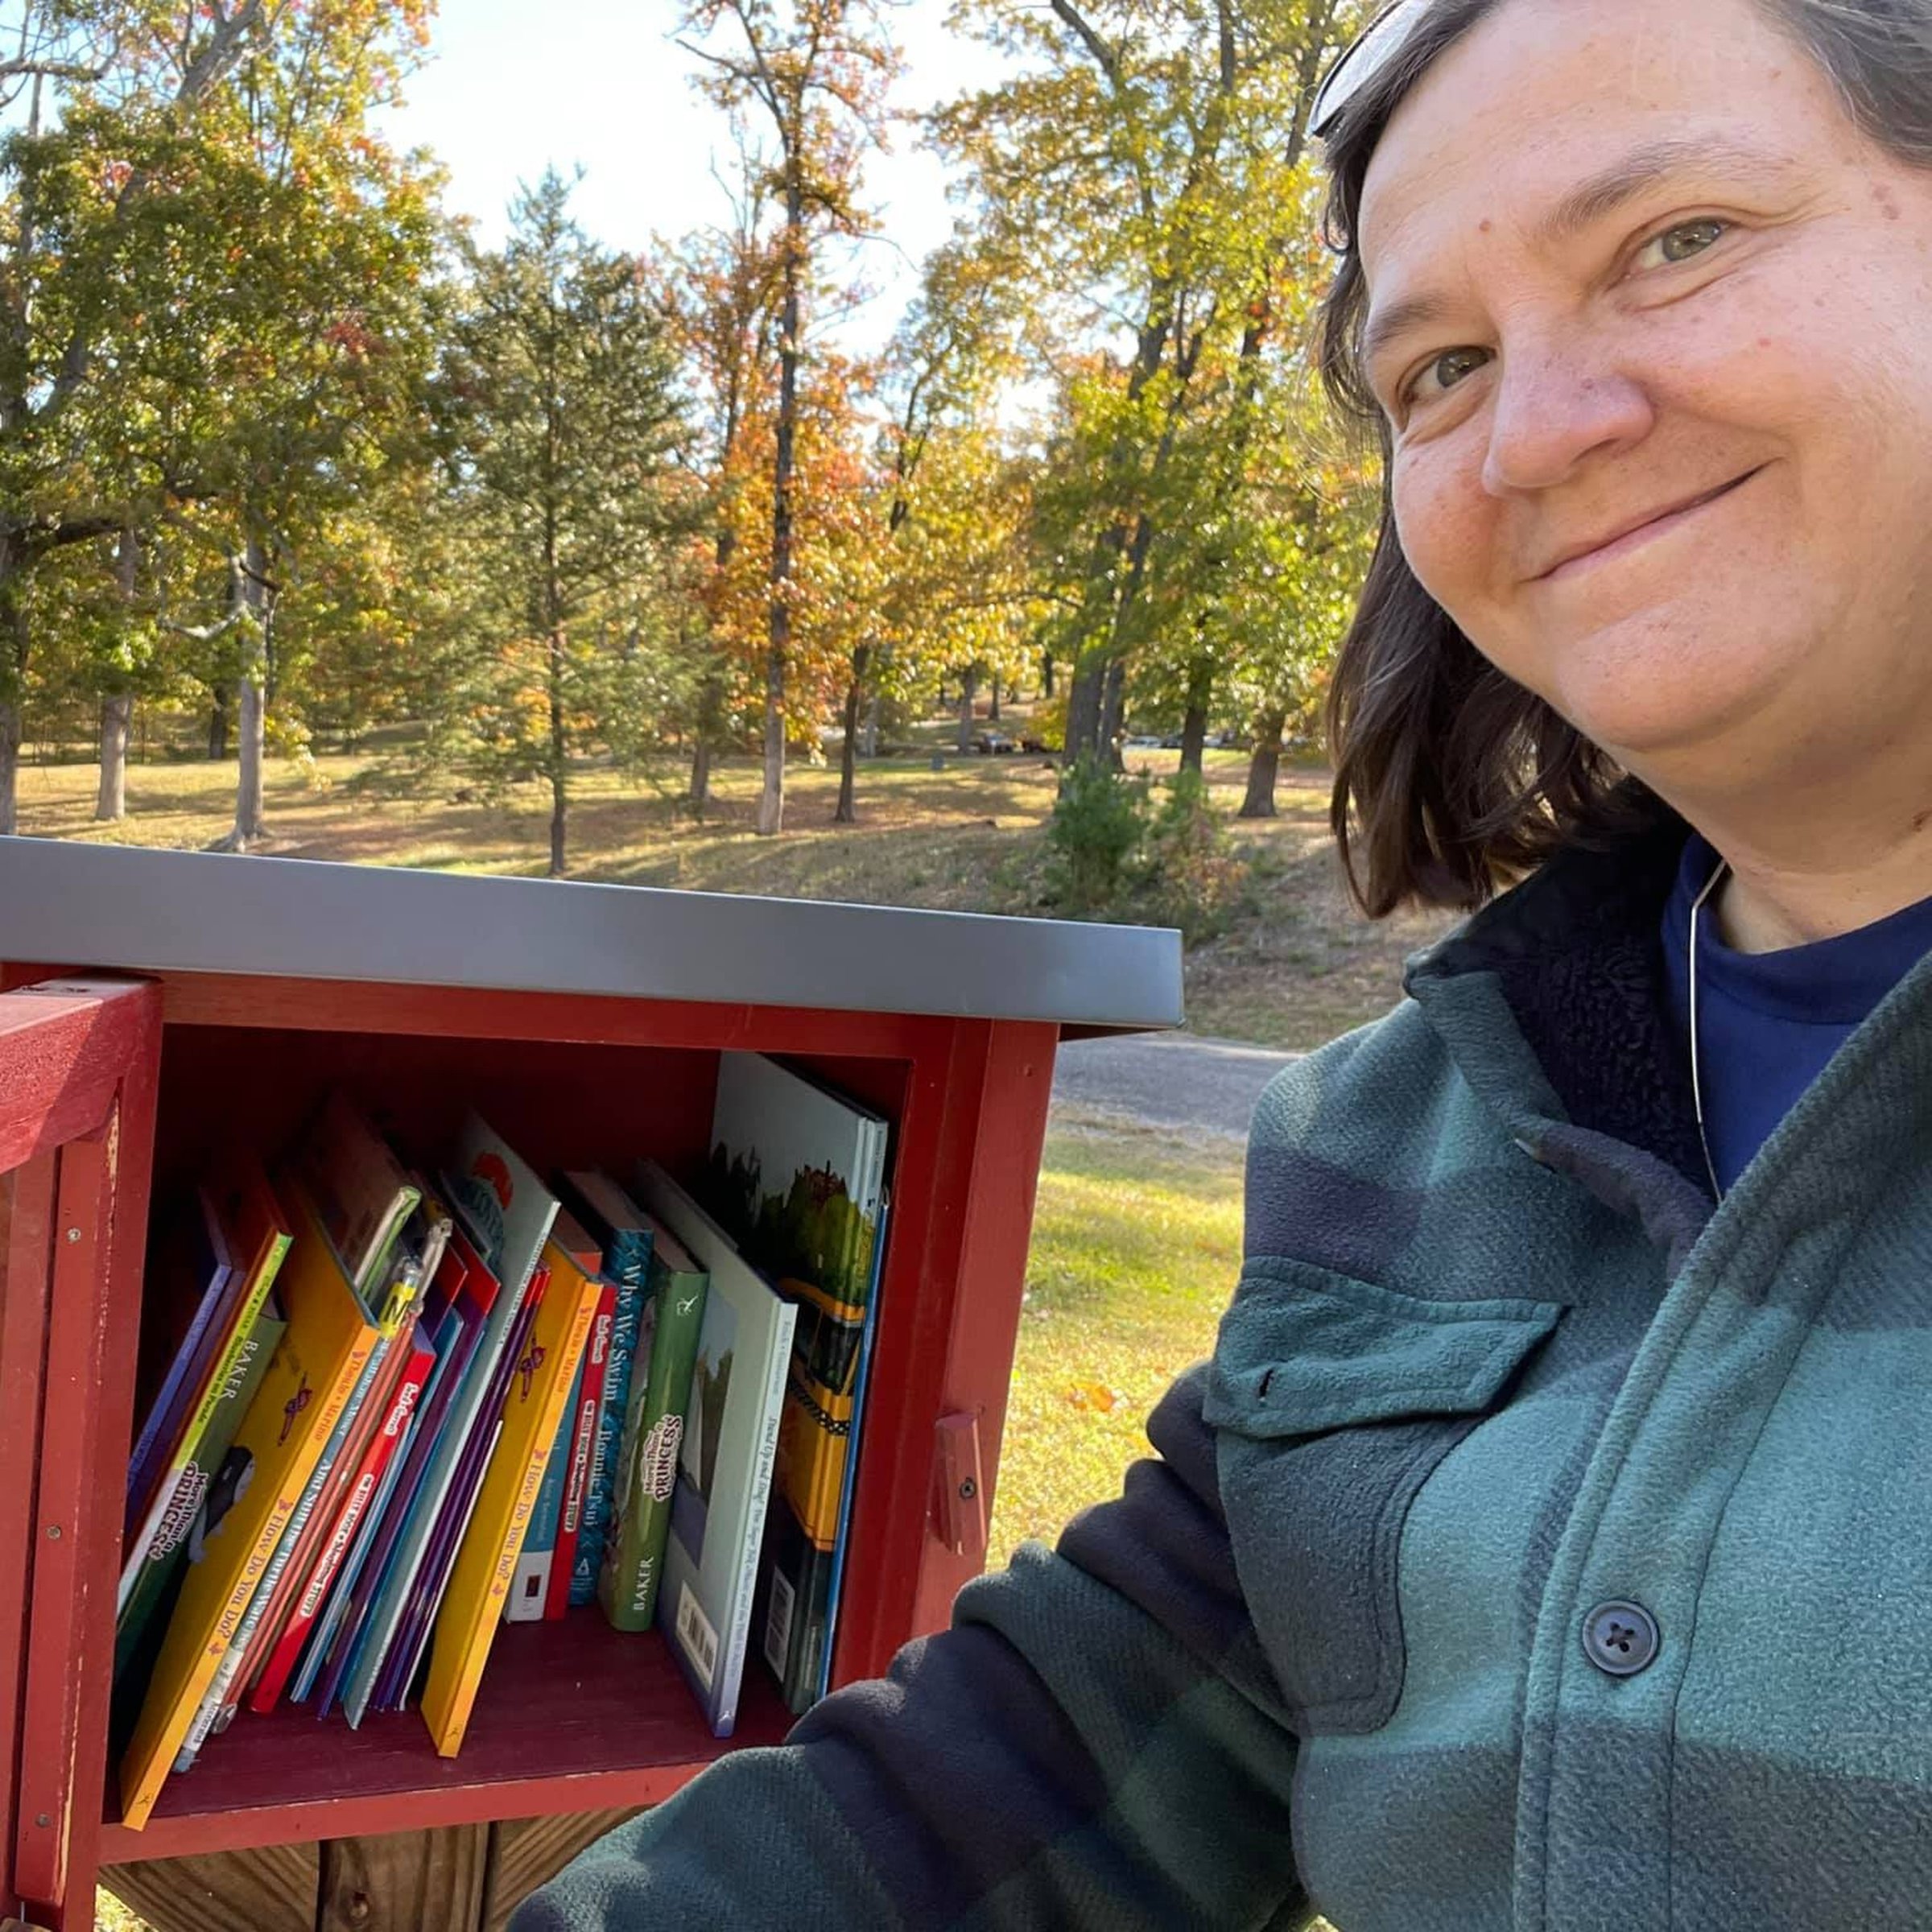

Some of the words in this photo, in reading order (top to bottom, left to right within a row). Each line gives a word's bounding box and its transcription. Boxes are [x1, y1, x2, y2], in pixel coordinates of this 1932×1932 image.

[616, 1262, 641, 1308] Why
[612, 1312, 631, 1345] We
[219, 1340, 258, 1402] BAKER
[605, 1348, 625, 1401] Swim
[315, 1403, 339, 1441] Marino
[766, 1417, 777, 1444] Stand
[591, 1428, 613, 1488] Bonnie
[647, 1432, 660, 1459] Than
[654, 1416, 680, 1499] PRINCESS
[760, 1445, 773, 1457] Up
[312, 1459, 332, 1489] And
[523, 1463, 541, 1496] How
[645, 1467, 654, 1491] More
[761, 1461, 770, 1478] and
[188, 1473, 206, 1505] More
[150, 1461, 198, 1559] PRINCESS
[297, 1491, 317, 1522] Still
[516, 1501, 530, 1521] Do
[565, 1503, 576, 1529] STUFF
[584, 1491, 602, 1525] Tsui
[171, 1509, 191, 1539] Than
[258, 1514, 283, 1550] How
[285, 1523, 302, 1546] the
[341, 1512, 356, 1534] BOOK
[506, 1523, 522, 1550] You
[247, 1554, 264, 1575] Do
[262, 1550, 290, 1594] Turtle
[497, 1553, 512, 1579] Do?
[233, 1577, 254, 1606] You
[634, 1556, 652, 1610] BAKER
[303, 1585, 322, 1614] STUFF
[217, 1608, 238, 1638] Do?
